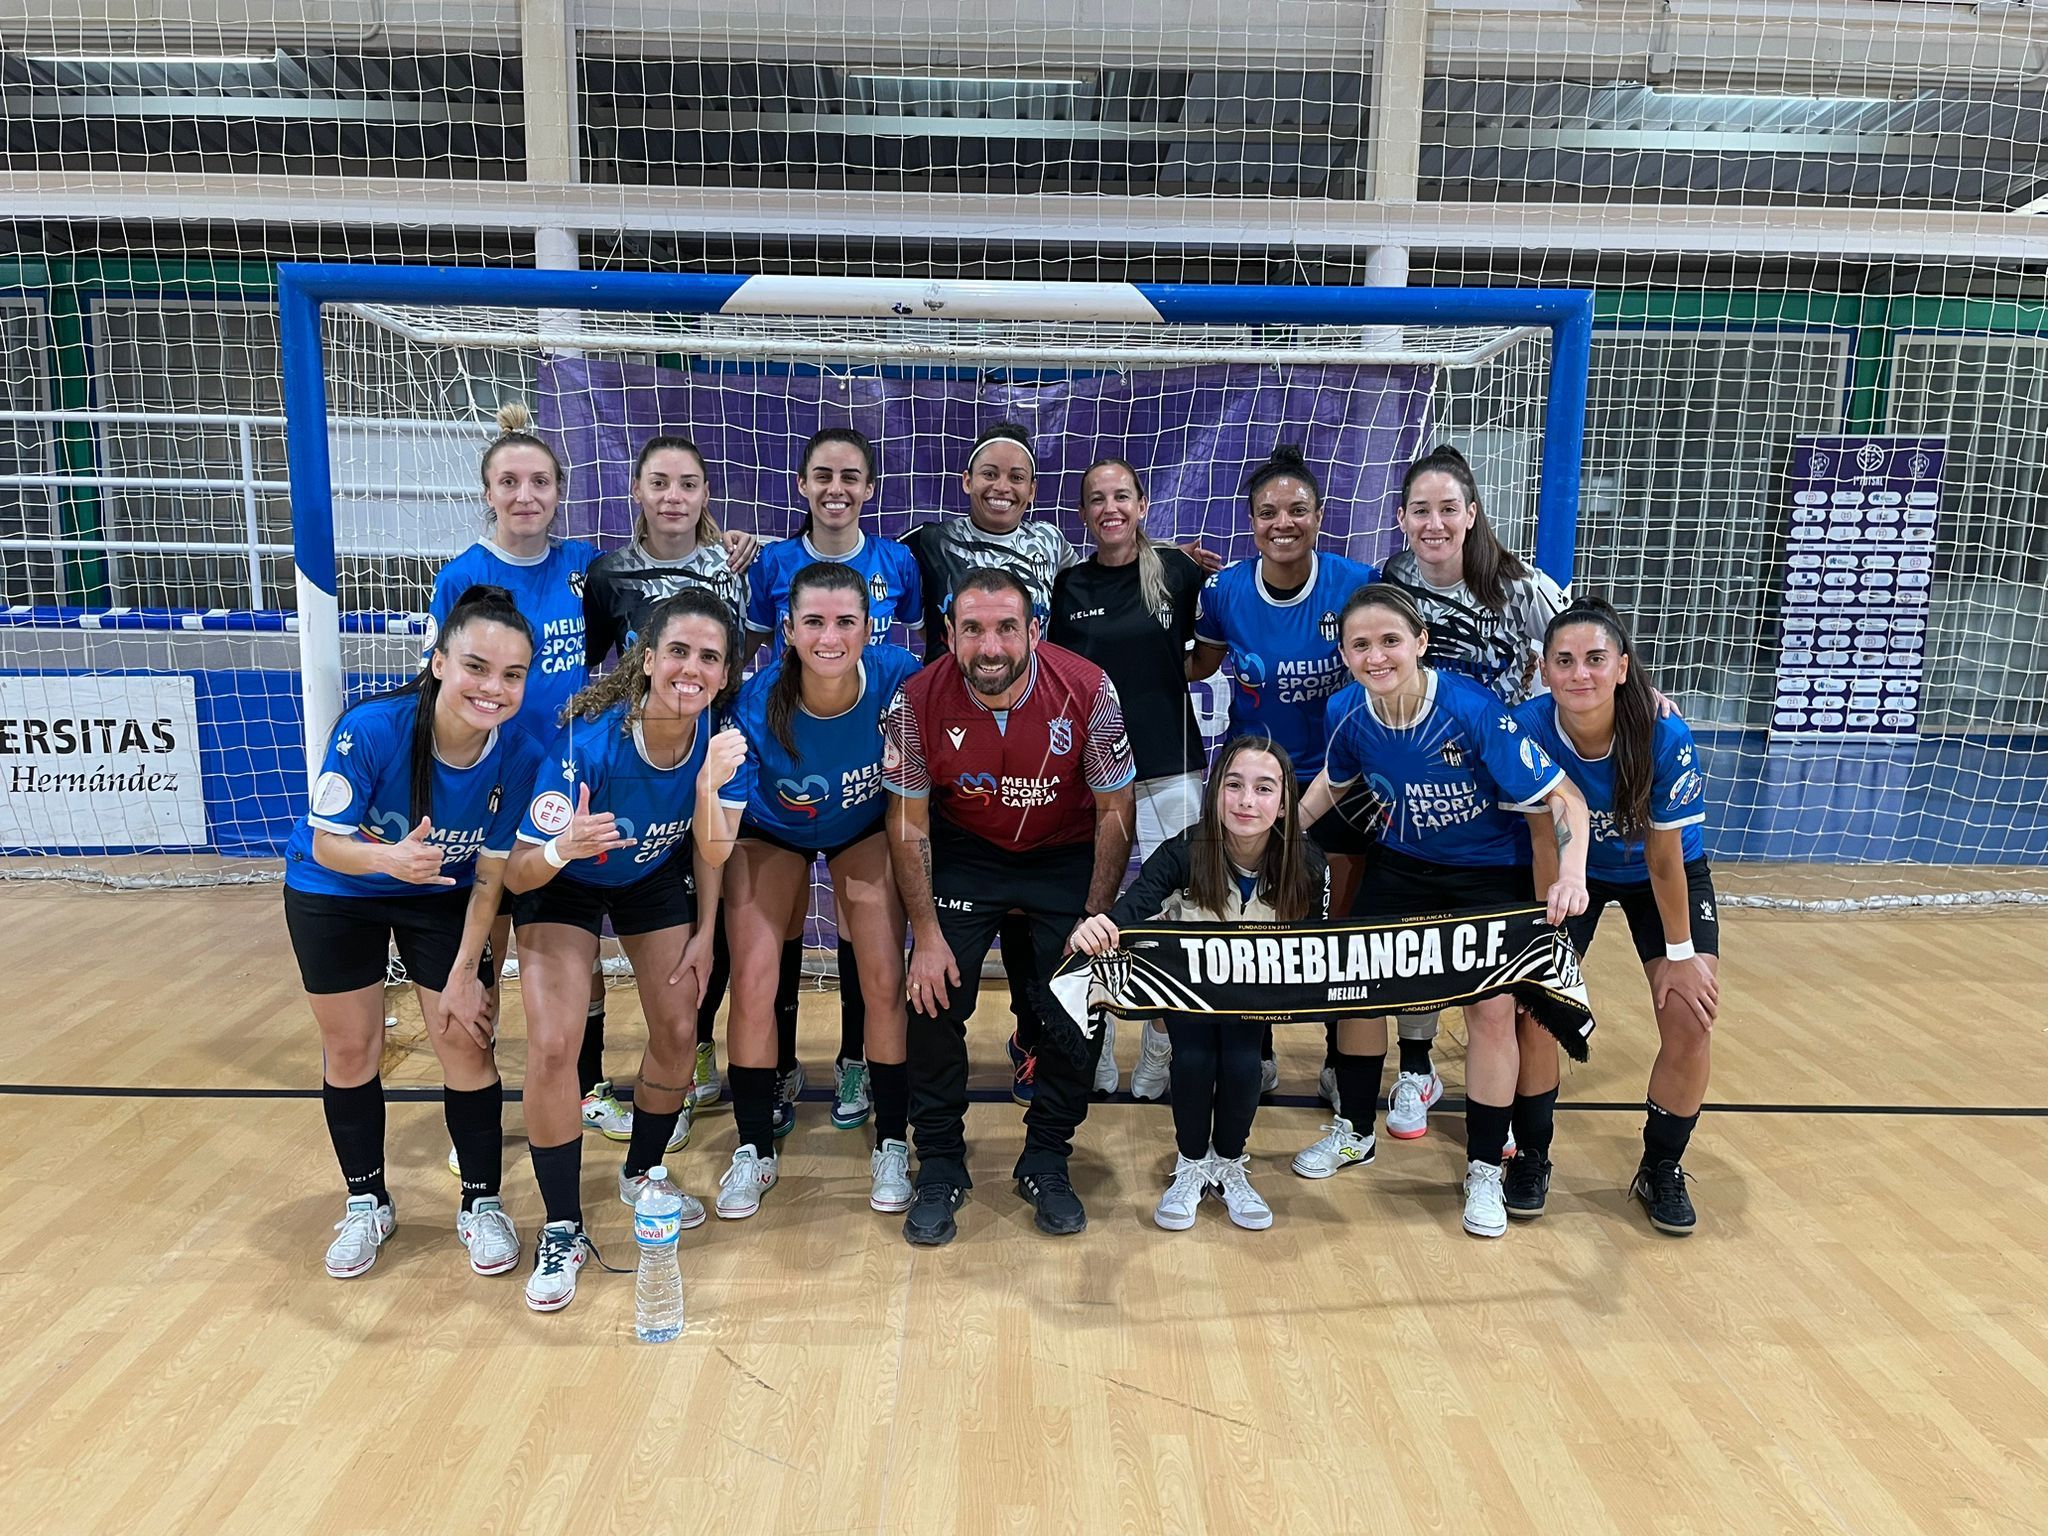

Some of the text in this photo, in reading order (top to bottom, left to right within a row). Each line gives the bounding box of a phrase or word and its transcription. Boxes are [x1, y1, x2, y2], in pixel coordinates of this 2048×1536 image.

[1069, 608, 1106, 621] KELME
[541, 633, 586, 655] SPOR
[1277, 655, 1344, 676] MELILL
[1278, 670, 1342, 690] SPORT
[0, 718, 176, 755] ERSITAS
[9, 763, 179, 793] Hernández
[1001, 775, 1061, 789] MELILLA
[841, 785, 884, 809] CAP
[1001, 785, 1050, 798] SPORT
[1001, 789, 1058, 808] CAPITAL
[1407, 793, 1475, 814] SPORT
[1411, 798, 1491, 828] CAPITAL
[639, 832, 685, 851] SPO
[1180, 919, 1509, 985] TORREBLANCA C.F.
[1327, 985, 1368, 1001] MELILLA
